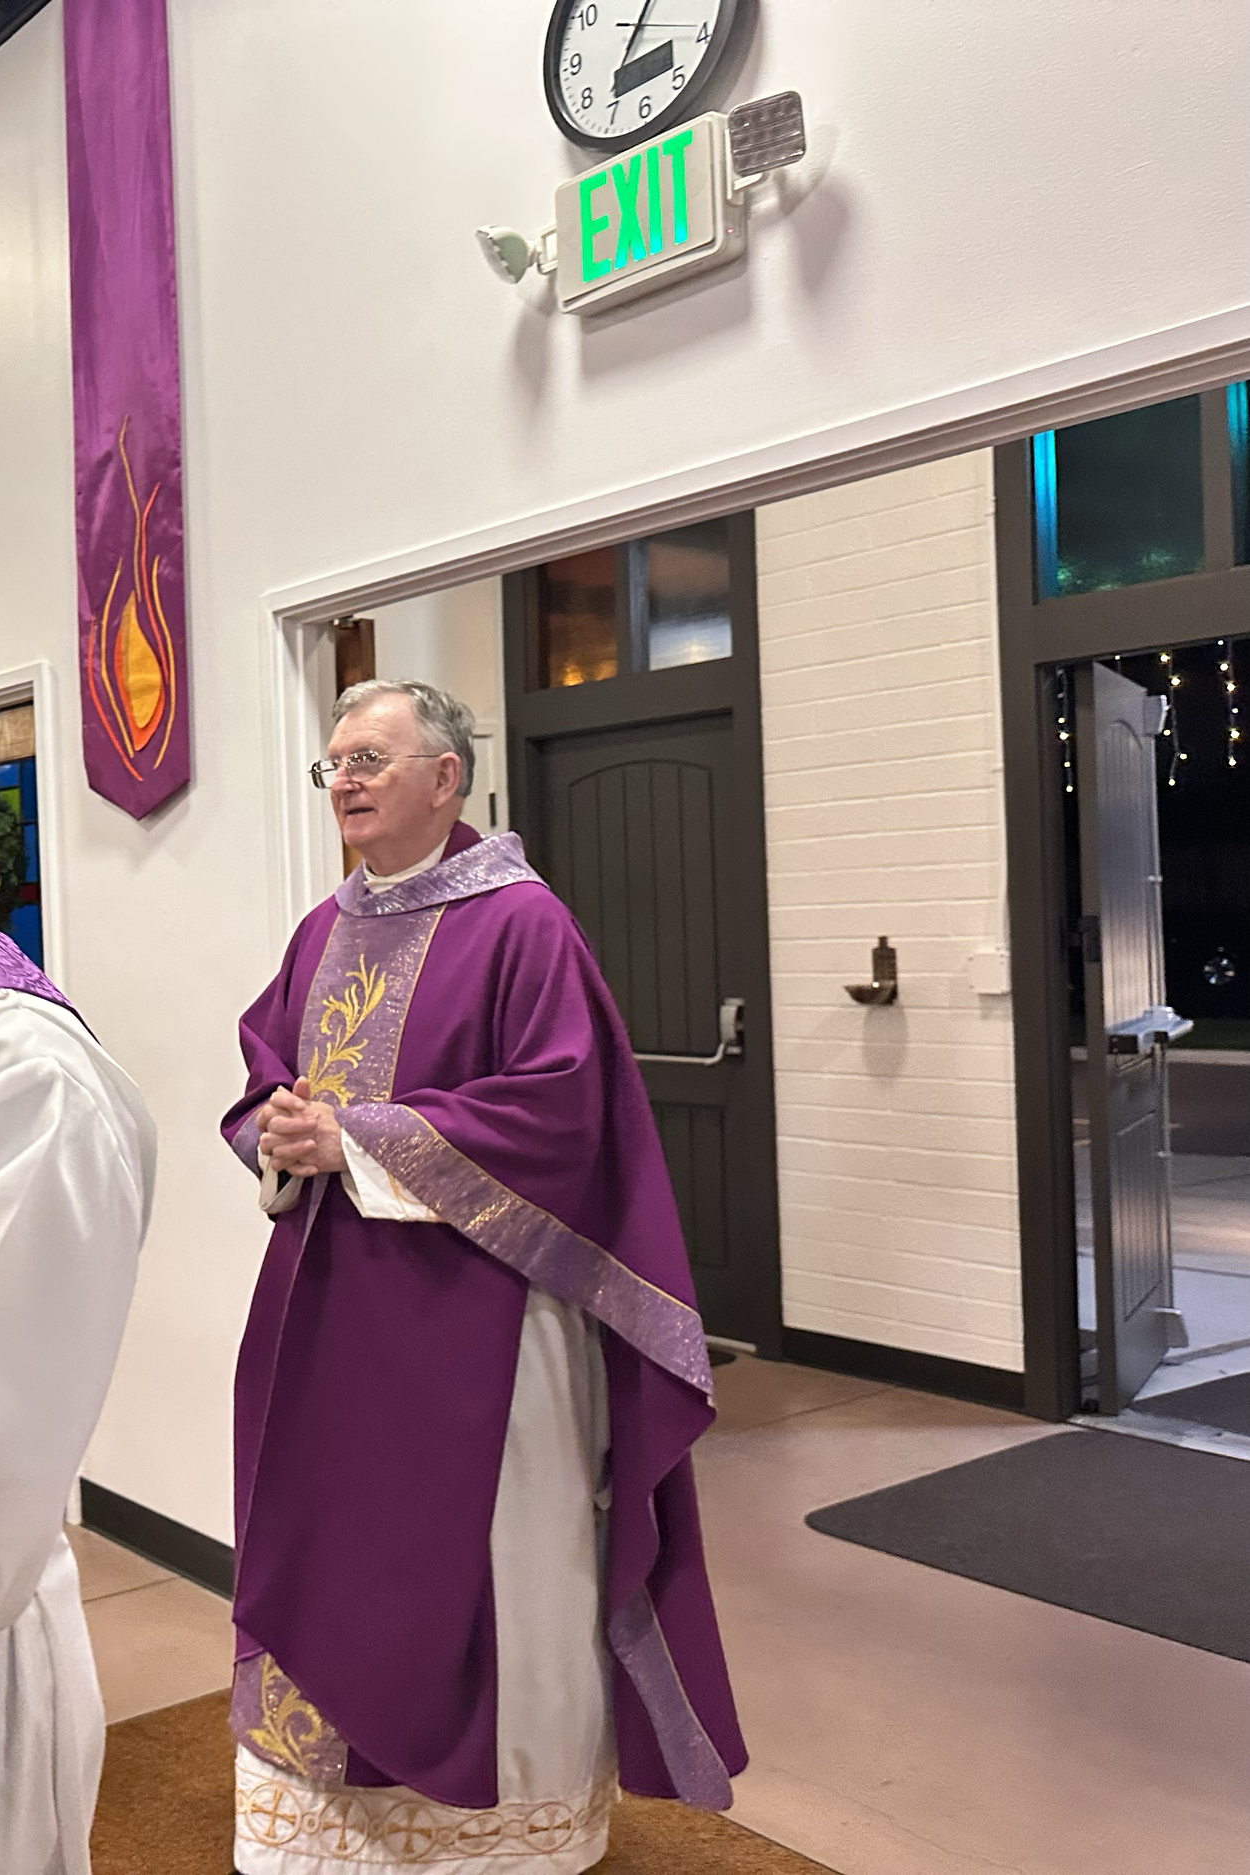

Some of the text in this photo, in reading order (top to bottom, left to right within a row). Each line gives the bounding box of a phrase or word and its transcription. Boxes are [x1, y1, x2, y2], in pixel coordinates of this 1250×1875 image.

[577, 3, 598, 31] 10
[696, 21, 712, 44] 4
[570, 53, 582, 76] 9
[672, 65, 685, 91] 5
[581, 87, 593, 110] 8
[639, 95, 652, 119] 6
[606, 100, 620, 125] 7
[579, 129, 693, 283] EXIT
